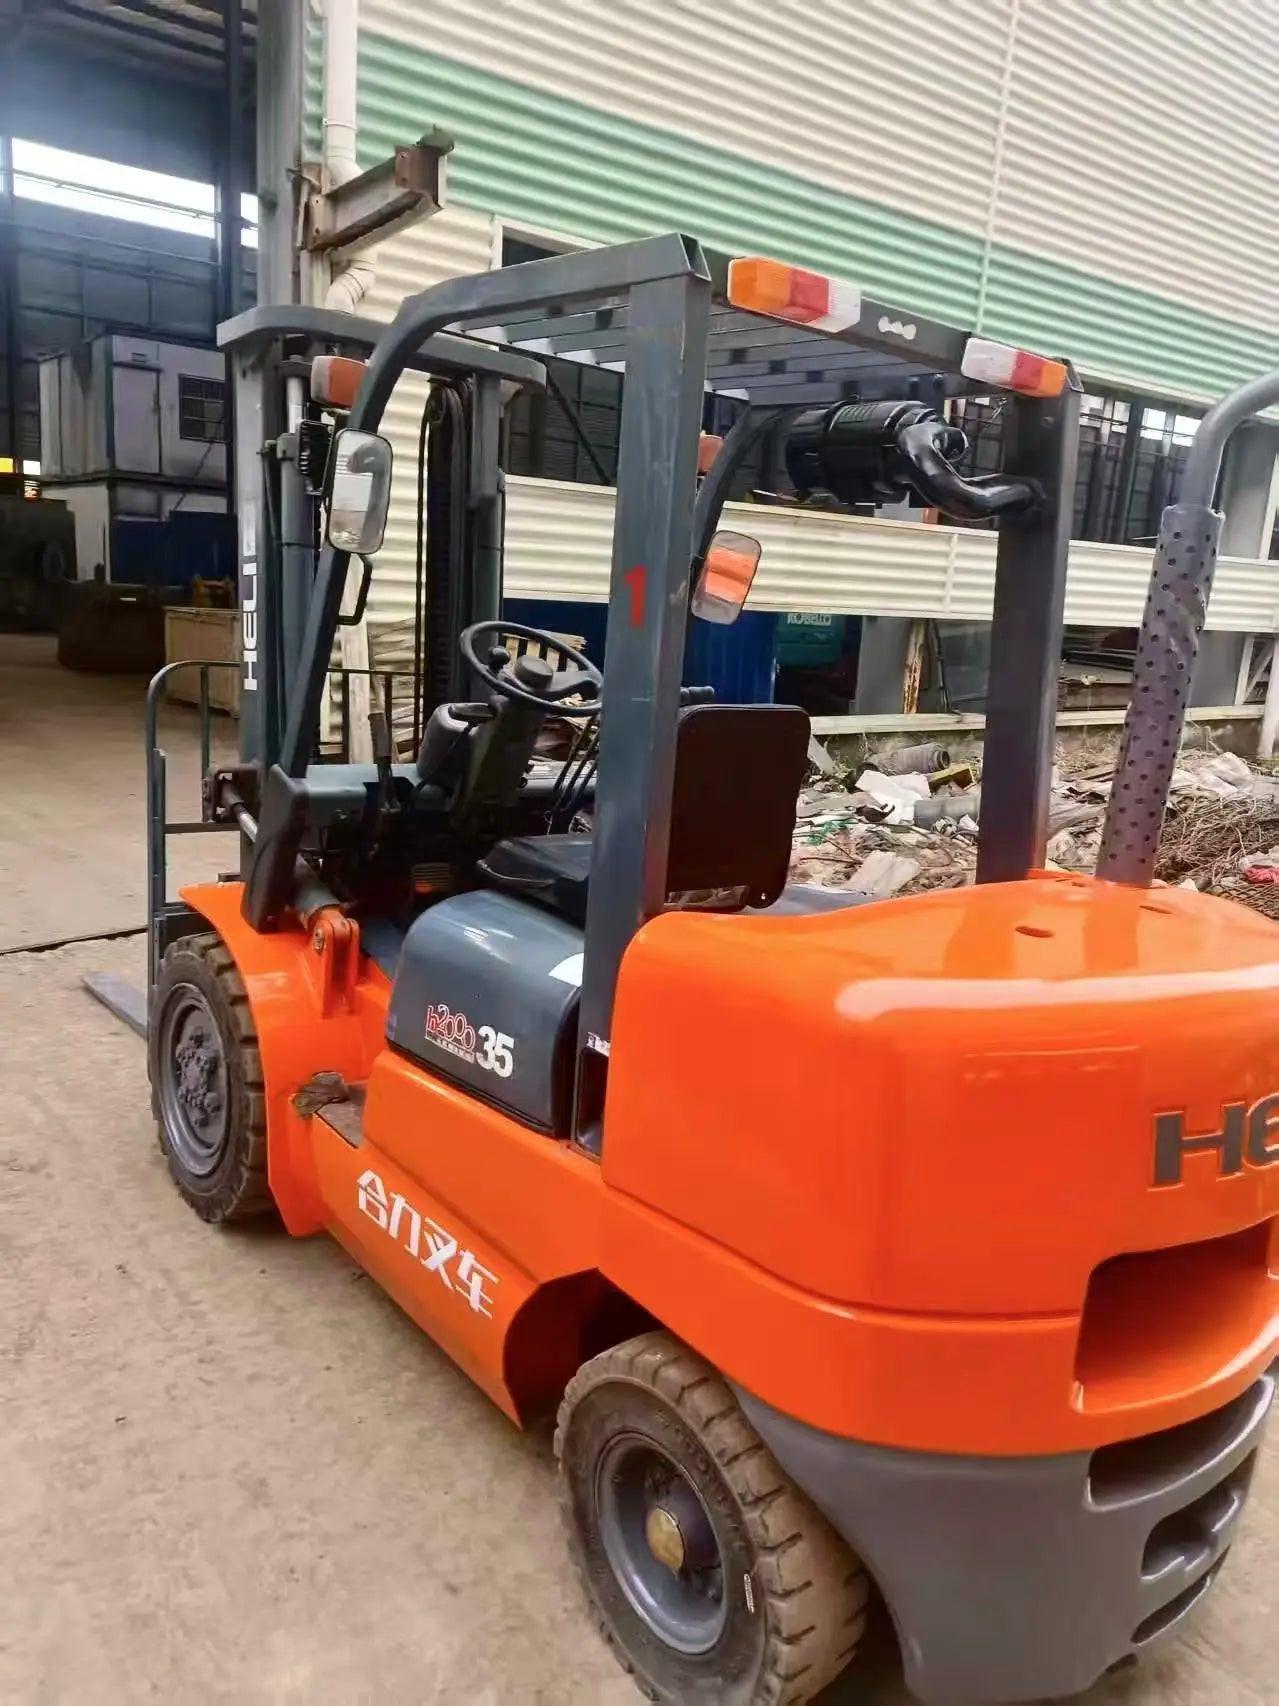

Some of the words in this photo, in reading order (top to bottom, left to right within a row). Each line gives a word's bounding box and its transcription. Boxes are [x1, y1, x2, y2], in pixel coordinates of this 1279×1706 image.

[242, 562, 258, 691] HELI
[624, 564, 646, 630] 1
[478, 1025, 514, 1078] 35
[357, 1169, 499, 1320] 合力叉车
